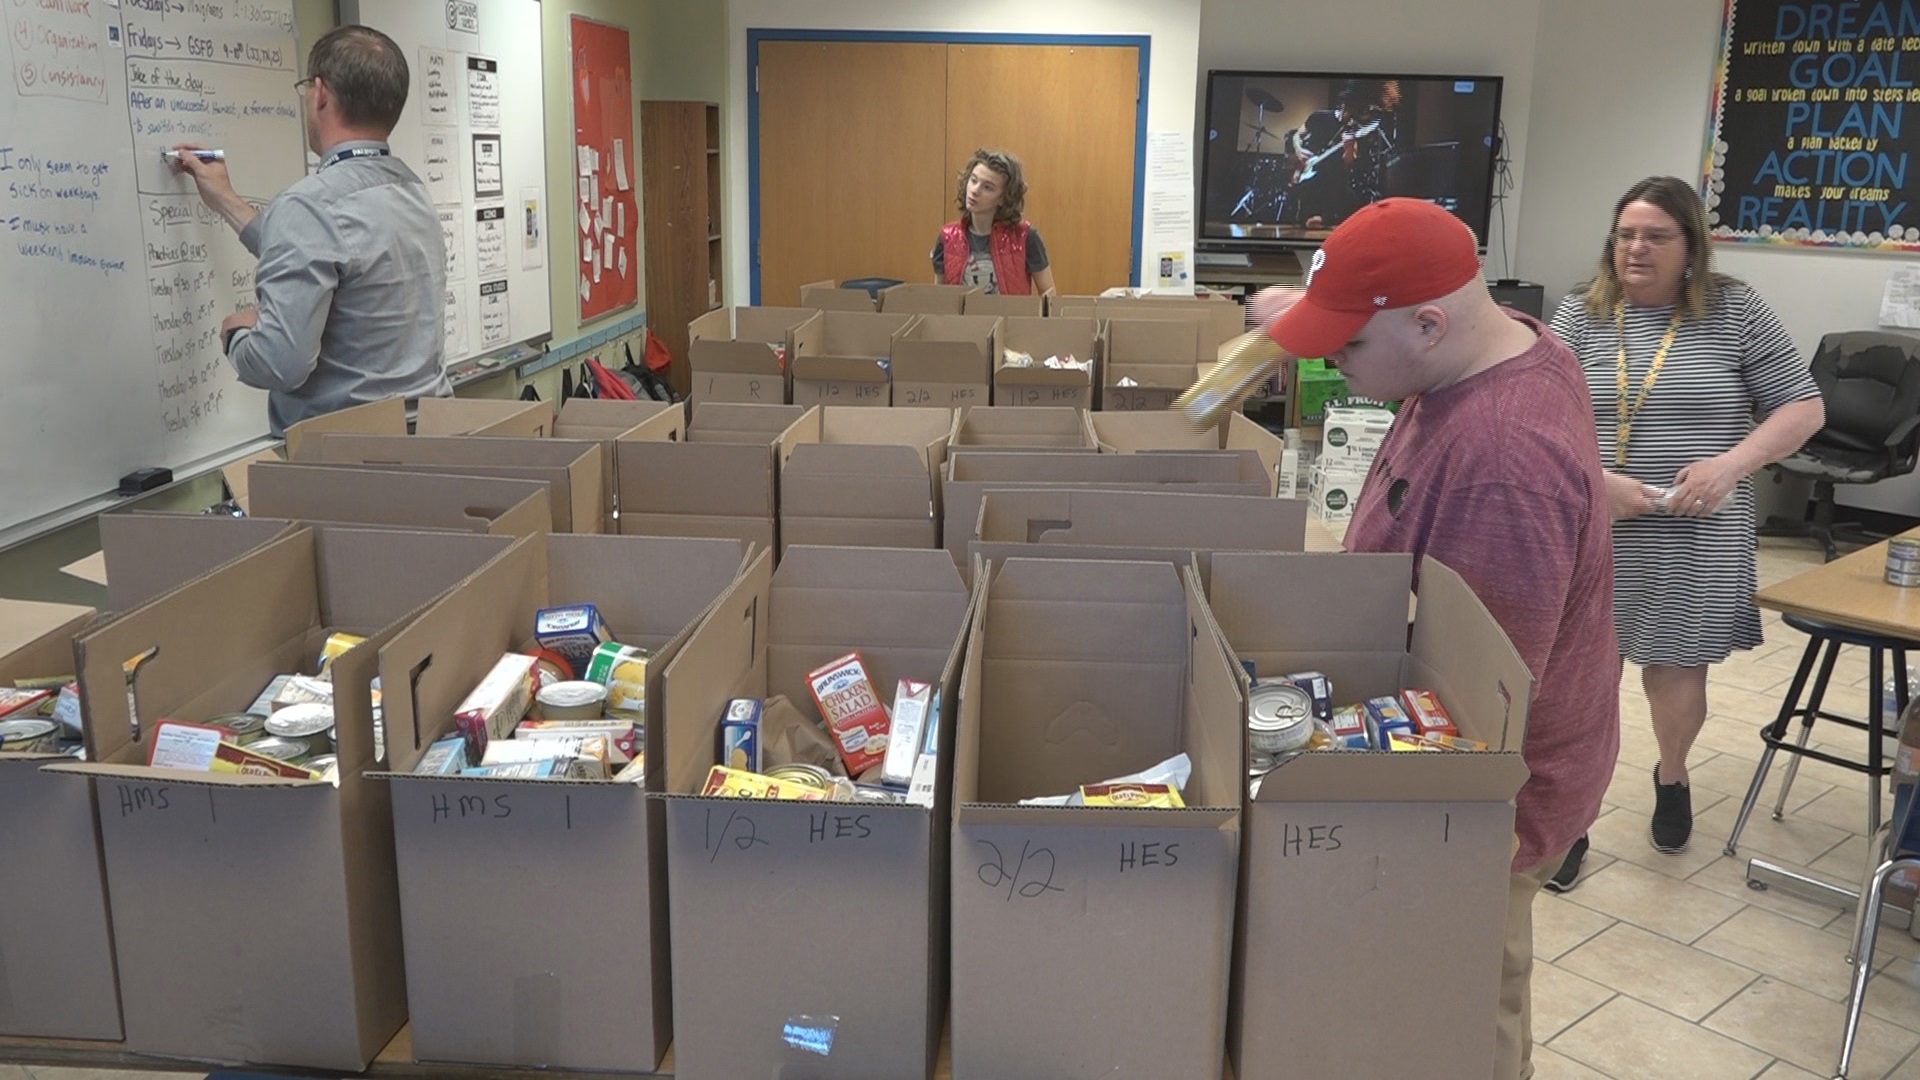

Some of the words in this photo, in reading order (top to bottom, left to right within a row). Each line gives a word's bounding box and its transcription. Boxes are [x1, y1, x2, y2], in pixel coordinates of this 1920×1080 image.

[127, 22, 164, 56] Fridays
[1744, 41, 1785, 55] written
[1792, 39, 1821, 53] down
[1827, 38, 1853, 53] with
[1857, 39, 1865, 52] a
[1871, 37, 1896, 51] date
[1789, 51, 1913, 88] GOAL
[1735, 89, 1742, 101] a
[1747, 89, 1767, 101] goal
[1772, 89, 1806, 101] broken
[1811, 89, 1839, 101] down
[1873, 88, 1904, 102] steps
[1785, 102, 1903, 139] PLAN
[1787, 137, 1795, 149] a
[1801, 137, 1822, 149] plan
[1829, 137, 1862, 150] backed
[1866, 138, 1879, 151] by
[1753, 150, 1907, 189] ACTION
[1774, 185, 1811, 199] makes
[1819, 185, 1846, 199] your
[1850, 185, 1890, 200] dreams
[149, 199, 193, 234] Special
[1736, 196, 1906, 236] REALITY
[749, 380, 761, 400] R
[855, 386, 880, 399] HES
[951, 389, 975, 402] HES
[1052, 389, 1078, 400] HES
[816, 667, 861, 695] BRUNSWICK
[824, 682, 867, 709] CHICKEN
[831, 694, 872, 720] SALAD
[116, 784, 170, 818] HMS
[431, 792, 513, 824] HMS
[565, 794, 572, 830] 1
[706, 807, 770, 864] 1/2
[809, 811, 872, 843] HES
[1283, 823, 1344, 857] HES
[1443, 812, 1450, 843] 1
[976, 838, 1065, 902] 2/2
[1119, 841, 1179, 873] HES
